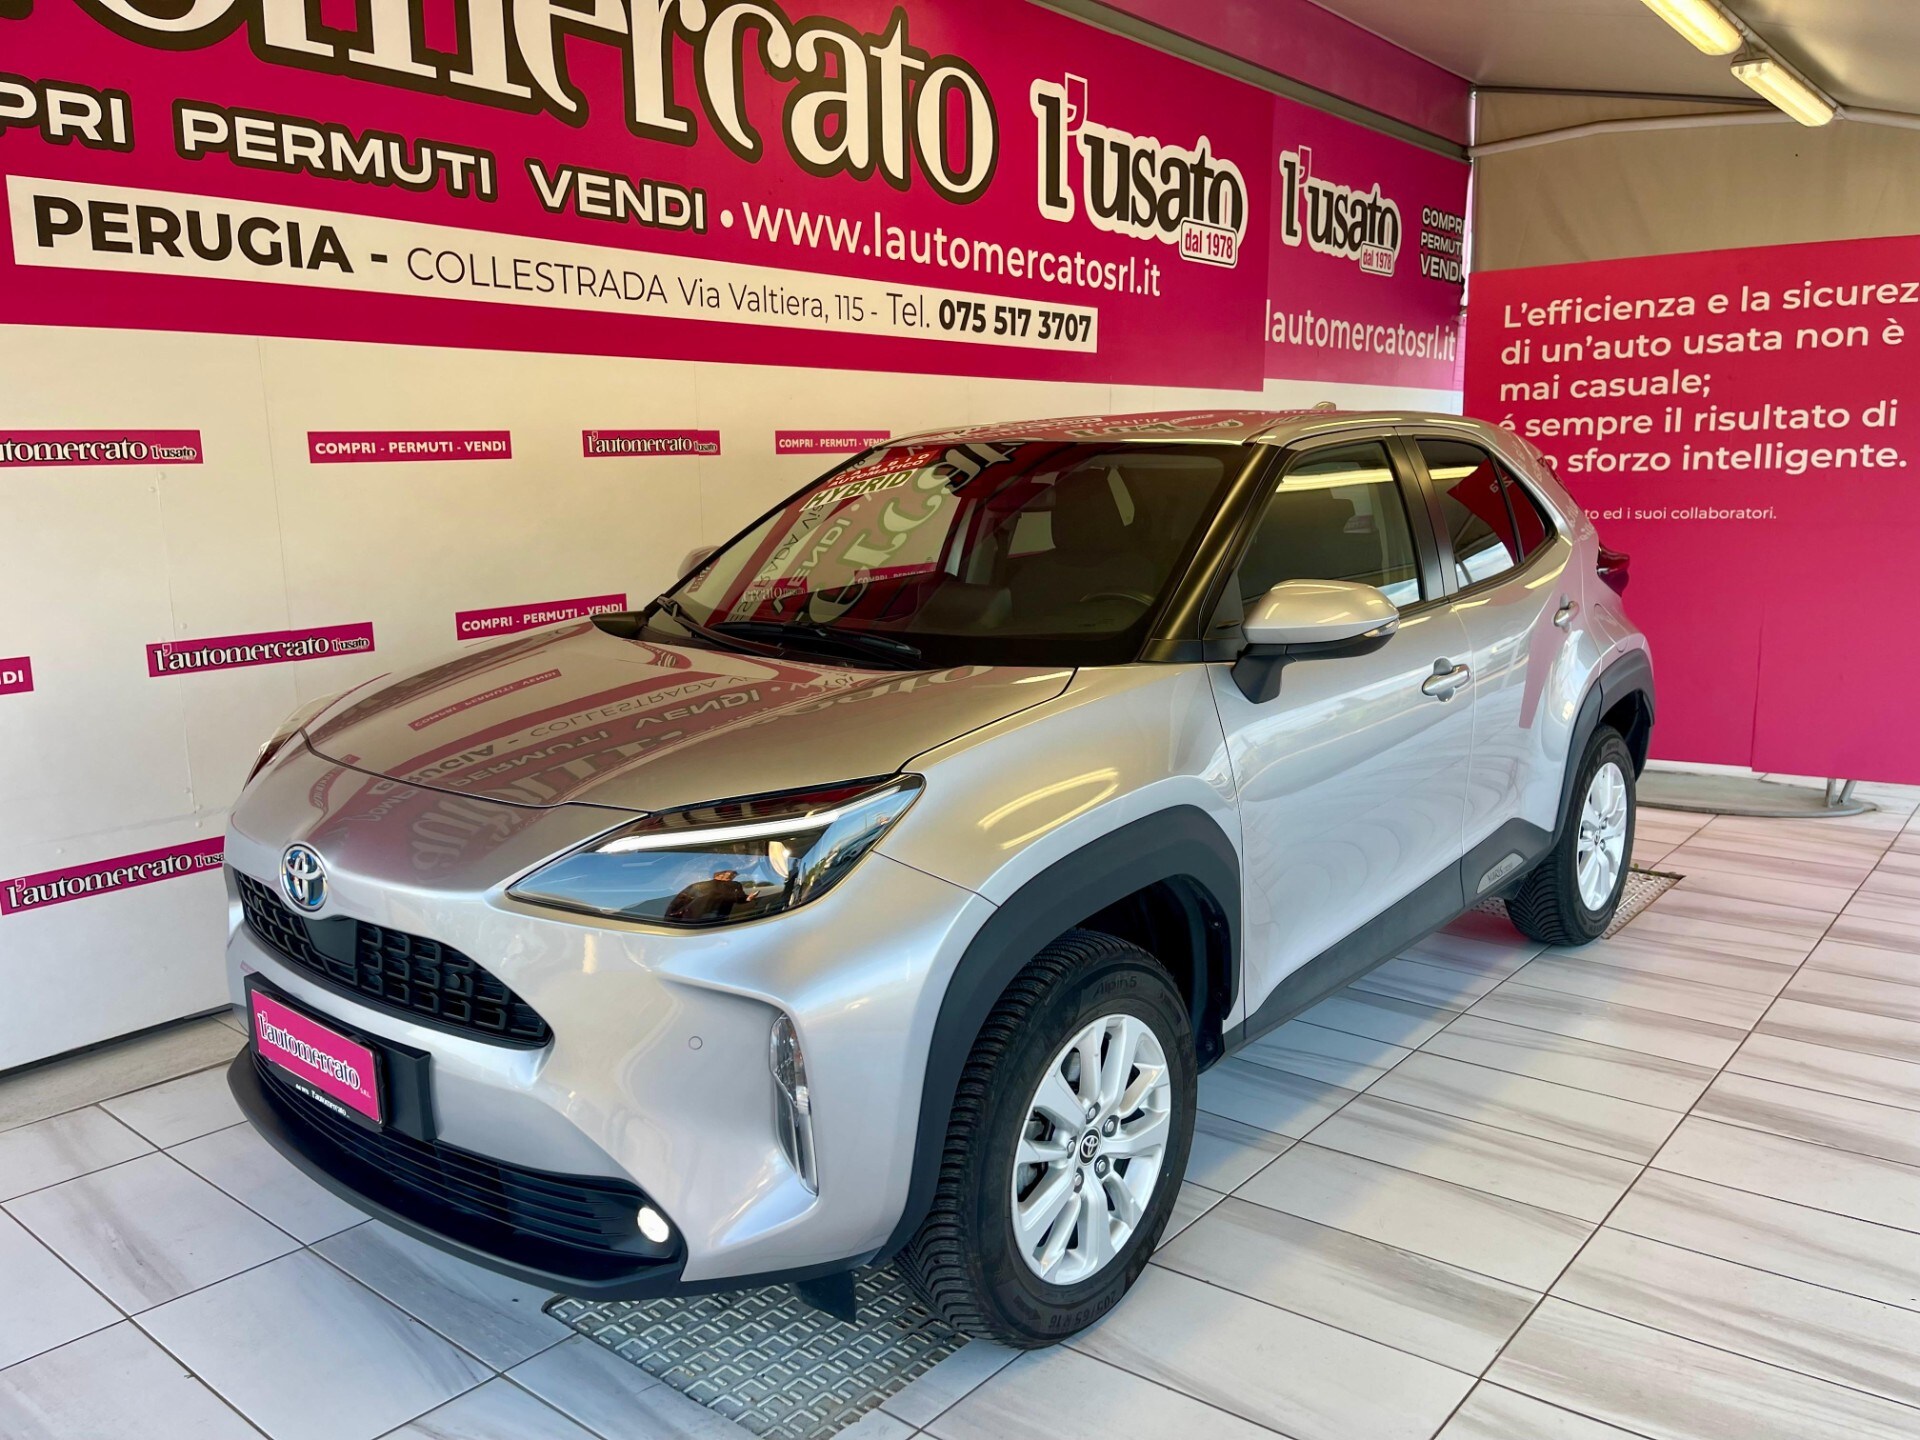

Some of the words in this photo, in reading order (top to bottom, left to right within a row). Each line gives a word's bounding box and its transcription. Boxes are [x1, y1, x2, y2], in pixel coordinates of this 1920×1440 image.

[1032, 72, 1246, 240] l'usato
[180, 108, 493, 195] PERMUTI
[528, 163, 705, 230] VENDI
[741, 201, 1161, 297] www.lautomercatosrl.it
[1281, 146, 1401, 256] l'usato
[1184, 226, 1203, 254] dal
[1205, 230, 1234, 260] 1978
[1362, 248, 1375, 267] dal
[1375, 251, 1392, 271] 1978
[32, 194, 354, 273] PERUGIA
[406, 247, 668, 305] COLLESTRADA
[677, 277, 721, 309] Via
[727, 282, 830, 324] Valtiera,
[834, 294, 865, 323] 115
[885, 292, 931, 329] Tel.
[938, 298, 986, 334] 075
[992, 304, 1032, 338] 517
[1036, 309, 1093, 344] 3707
[1420, 253, 1462, 283] VENDI
[1503, 294, 1696, 329] L'efficienza
[1706, 293, 1729, 314] e
[1741, 285, 1771, 313] la
[1782, 280, 1920, 310] sicurez
[1264, 298, 1456, 363] lautomercatosrl.it
[1501, 338, 1530, 366] di
[1541, 334, 1672, 363] un'auto
[1683, 326, 1783, 355] usata
[1796, 326, 1869, 349] non
[1881, 317, 1905, 345] è
[1499, 374, 1559, 402] mai
[1569, 368, 1712, 399] casuale;
[1525, 409, 1654, 441] sempre
[1664, 406, 1683, 433] il
[1693, 402, 1851, 433] risultato
[1861, 398, 1899, 428] di
[150, 444, 197, 460] l'usato
[315, 442, 376, 455] COMPRI
[388, 441, 453, 454] PERMUTI
[464, 440, 507, 453] VENDI
[586, 431, 693, 454] l'automercato
[778, 438, 814, 448] COMPRI
[820, 438, 857, 448] PERMUTI
[1566, 446, 1672, 474] sforzo
[1681, 441, 1908, 476] intelligente.
[804, 469, 915, 509] HYBRID
[827, 459, 924, 488] AUTOMATICO
[1603, 507, 1622, 520] ed
[1635, 508, 1667, 521] suoi
[1670, 506, 1778, 521] collaboratori.
[461, 616, 513, 632] COMPRI
[523, 608, 578, 625] PERMUTI
[7, 853, 193, 908] l'automercato
[257, 1010, 361, 1091] l'automercato
